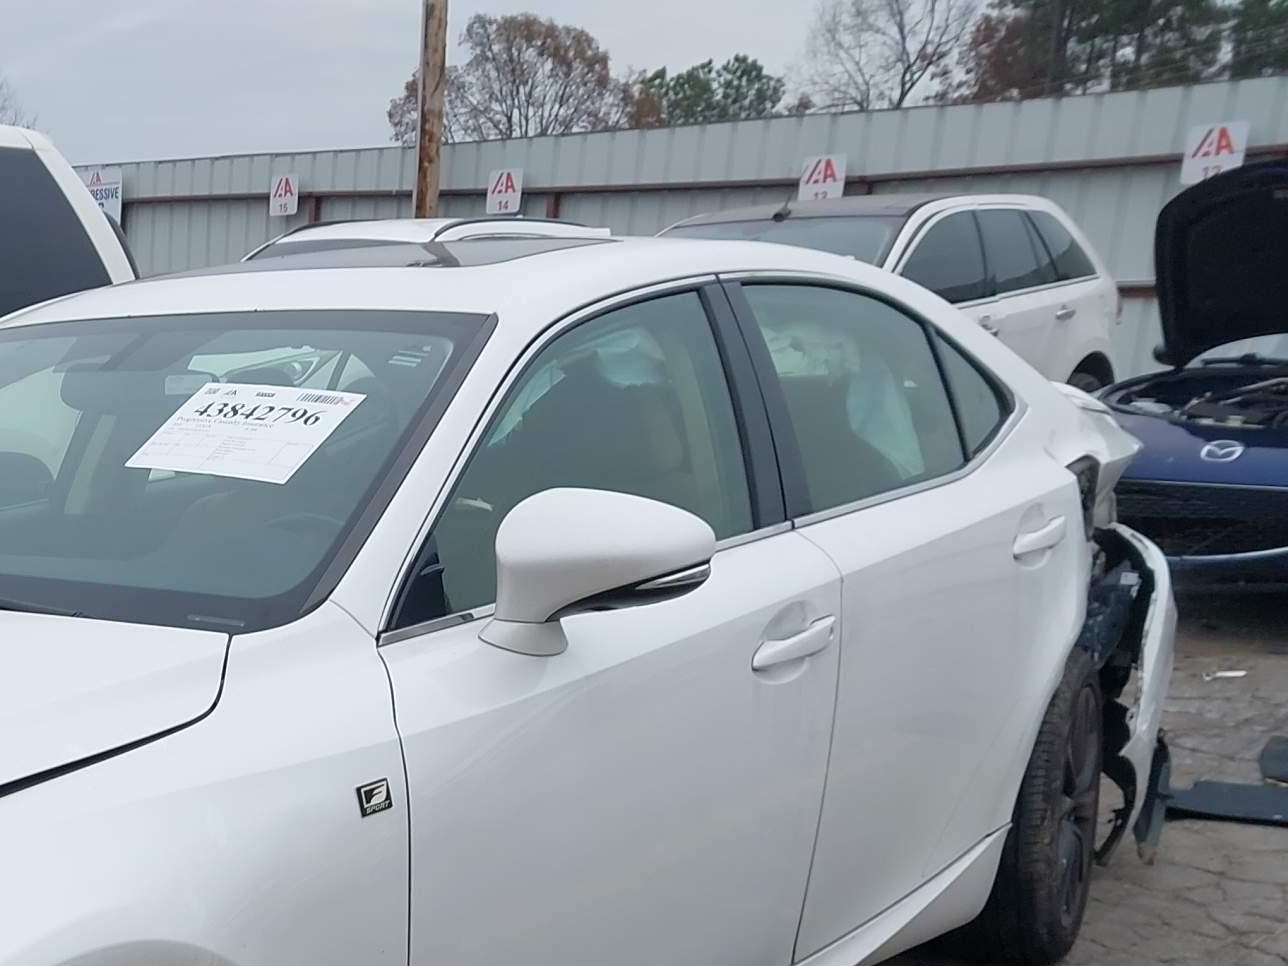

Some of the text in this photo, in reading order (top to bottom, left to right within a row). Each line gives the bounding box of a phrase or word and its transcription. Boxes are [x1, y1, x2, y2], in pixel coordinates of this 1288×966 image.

[498, 200, 509, 211] 14
[195, 401, 327, 426] 43842796
[366, 799, 390, 814] SPORT
